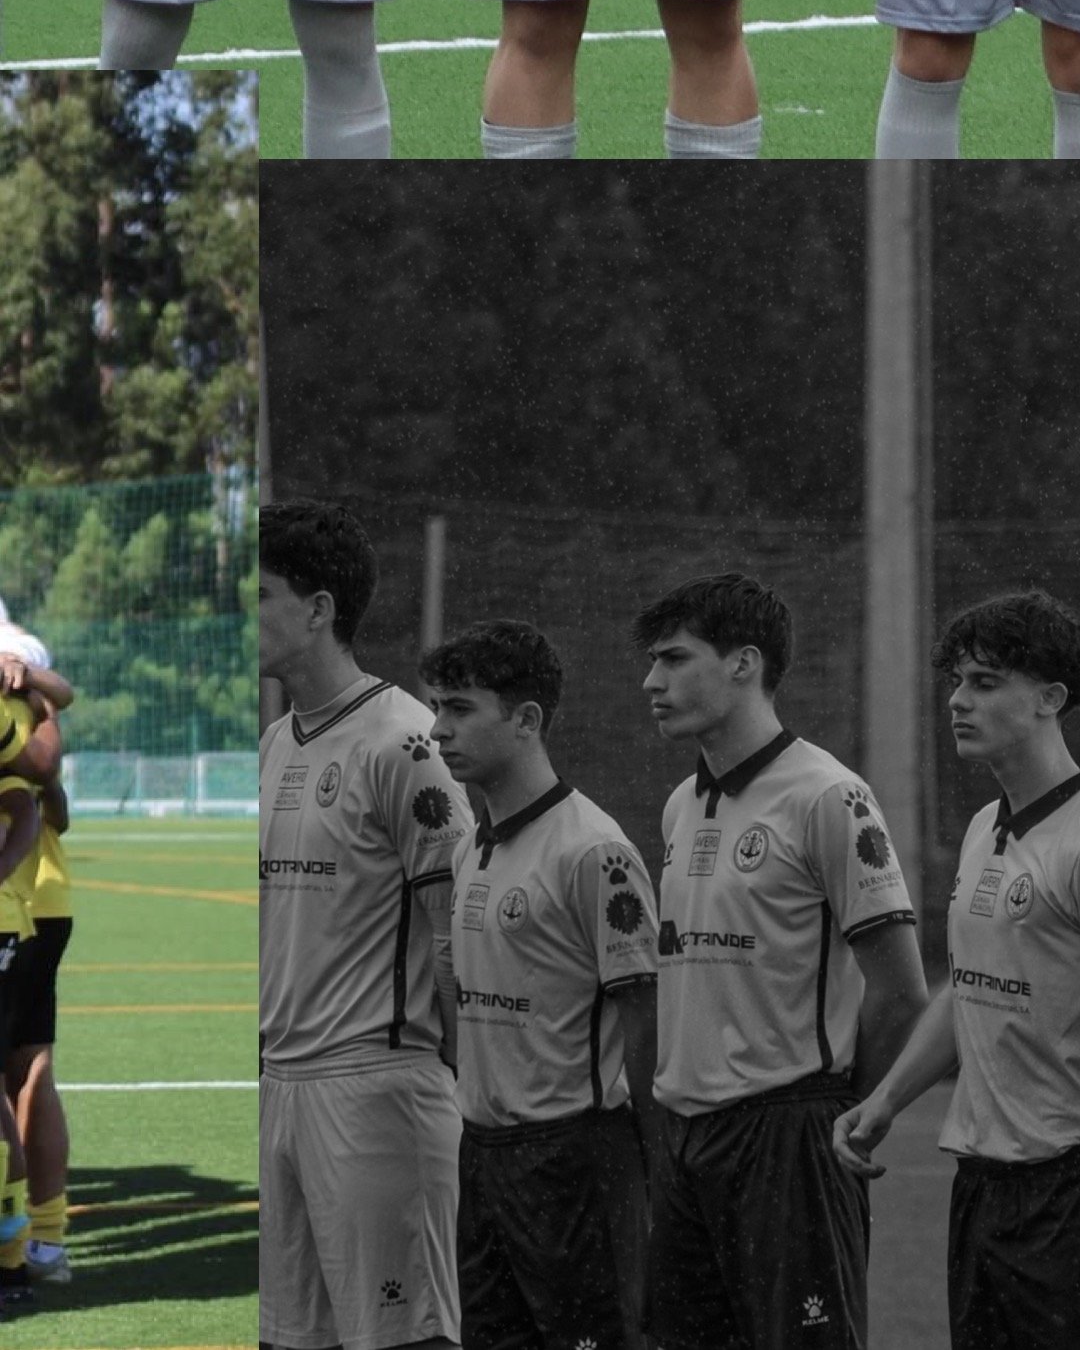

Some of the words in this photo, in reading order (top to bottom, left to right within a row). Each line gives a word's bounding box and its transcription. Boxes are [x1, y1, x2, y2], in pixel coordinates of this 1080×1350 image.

[417, 828, 466, 847] ERNARDO
[380, 1298, 408, 1308] KELME
[801, 1315, 830, 1326] KELME
